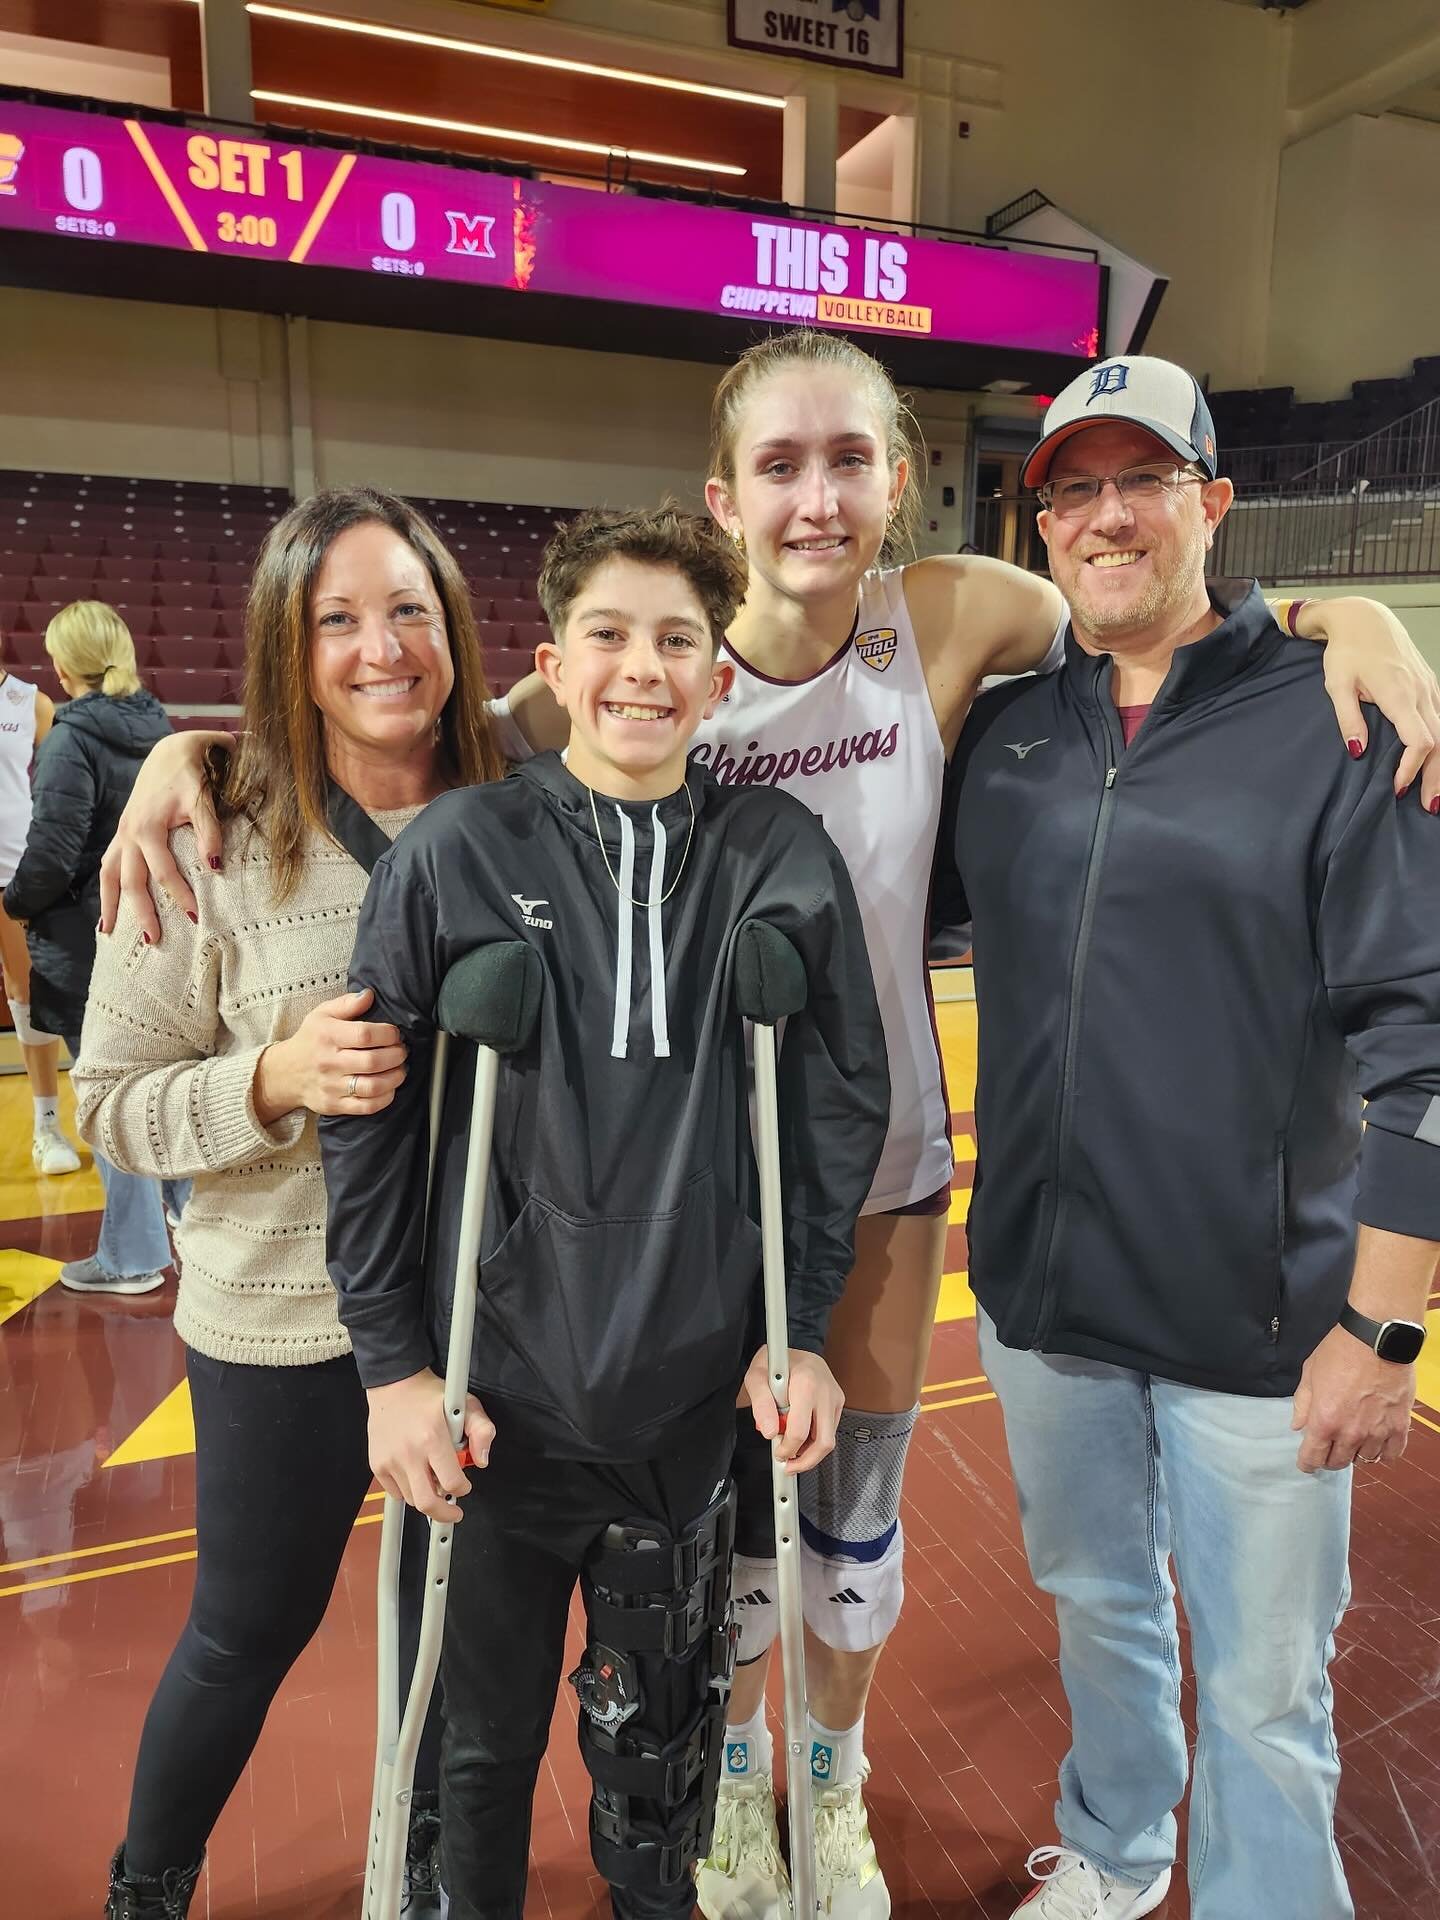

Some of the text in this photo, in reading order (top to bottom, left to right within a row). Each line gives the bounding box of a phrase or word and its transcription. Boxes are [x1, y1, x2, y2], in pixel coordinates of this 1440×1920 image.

[764, 10, 870, 56] SWEET 16
[63, 147, 103, 211] 0
[187, 135, 303, 202] SET 1
[217, 211, 277, 247] 3:00
[381, 192, 416, 252] 0
[752, 222, 908, 301] THIS IS
[720, 285, 925, 329] CHIPPEWA VOLLEYBALL
[858, 638, 897, 658] MAC
